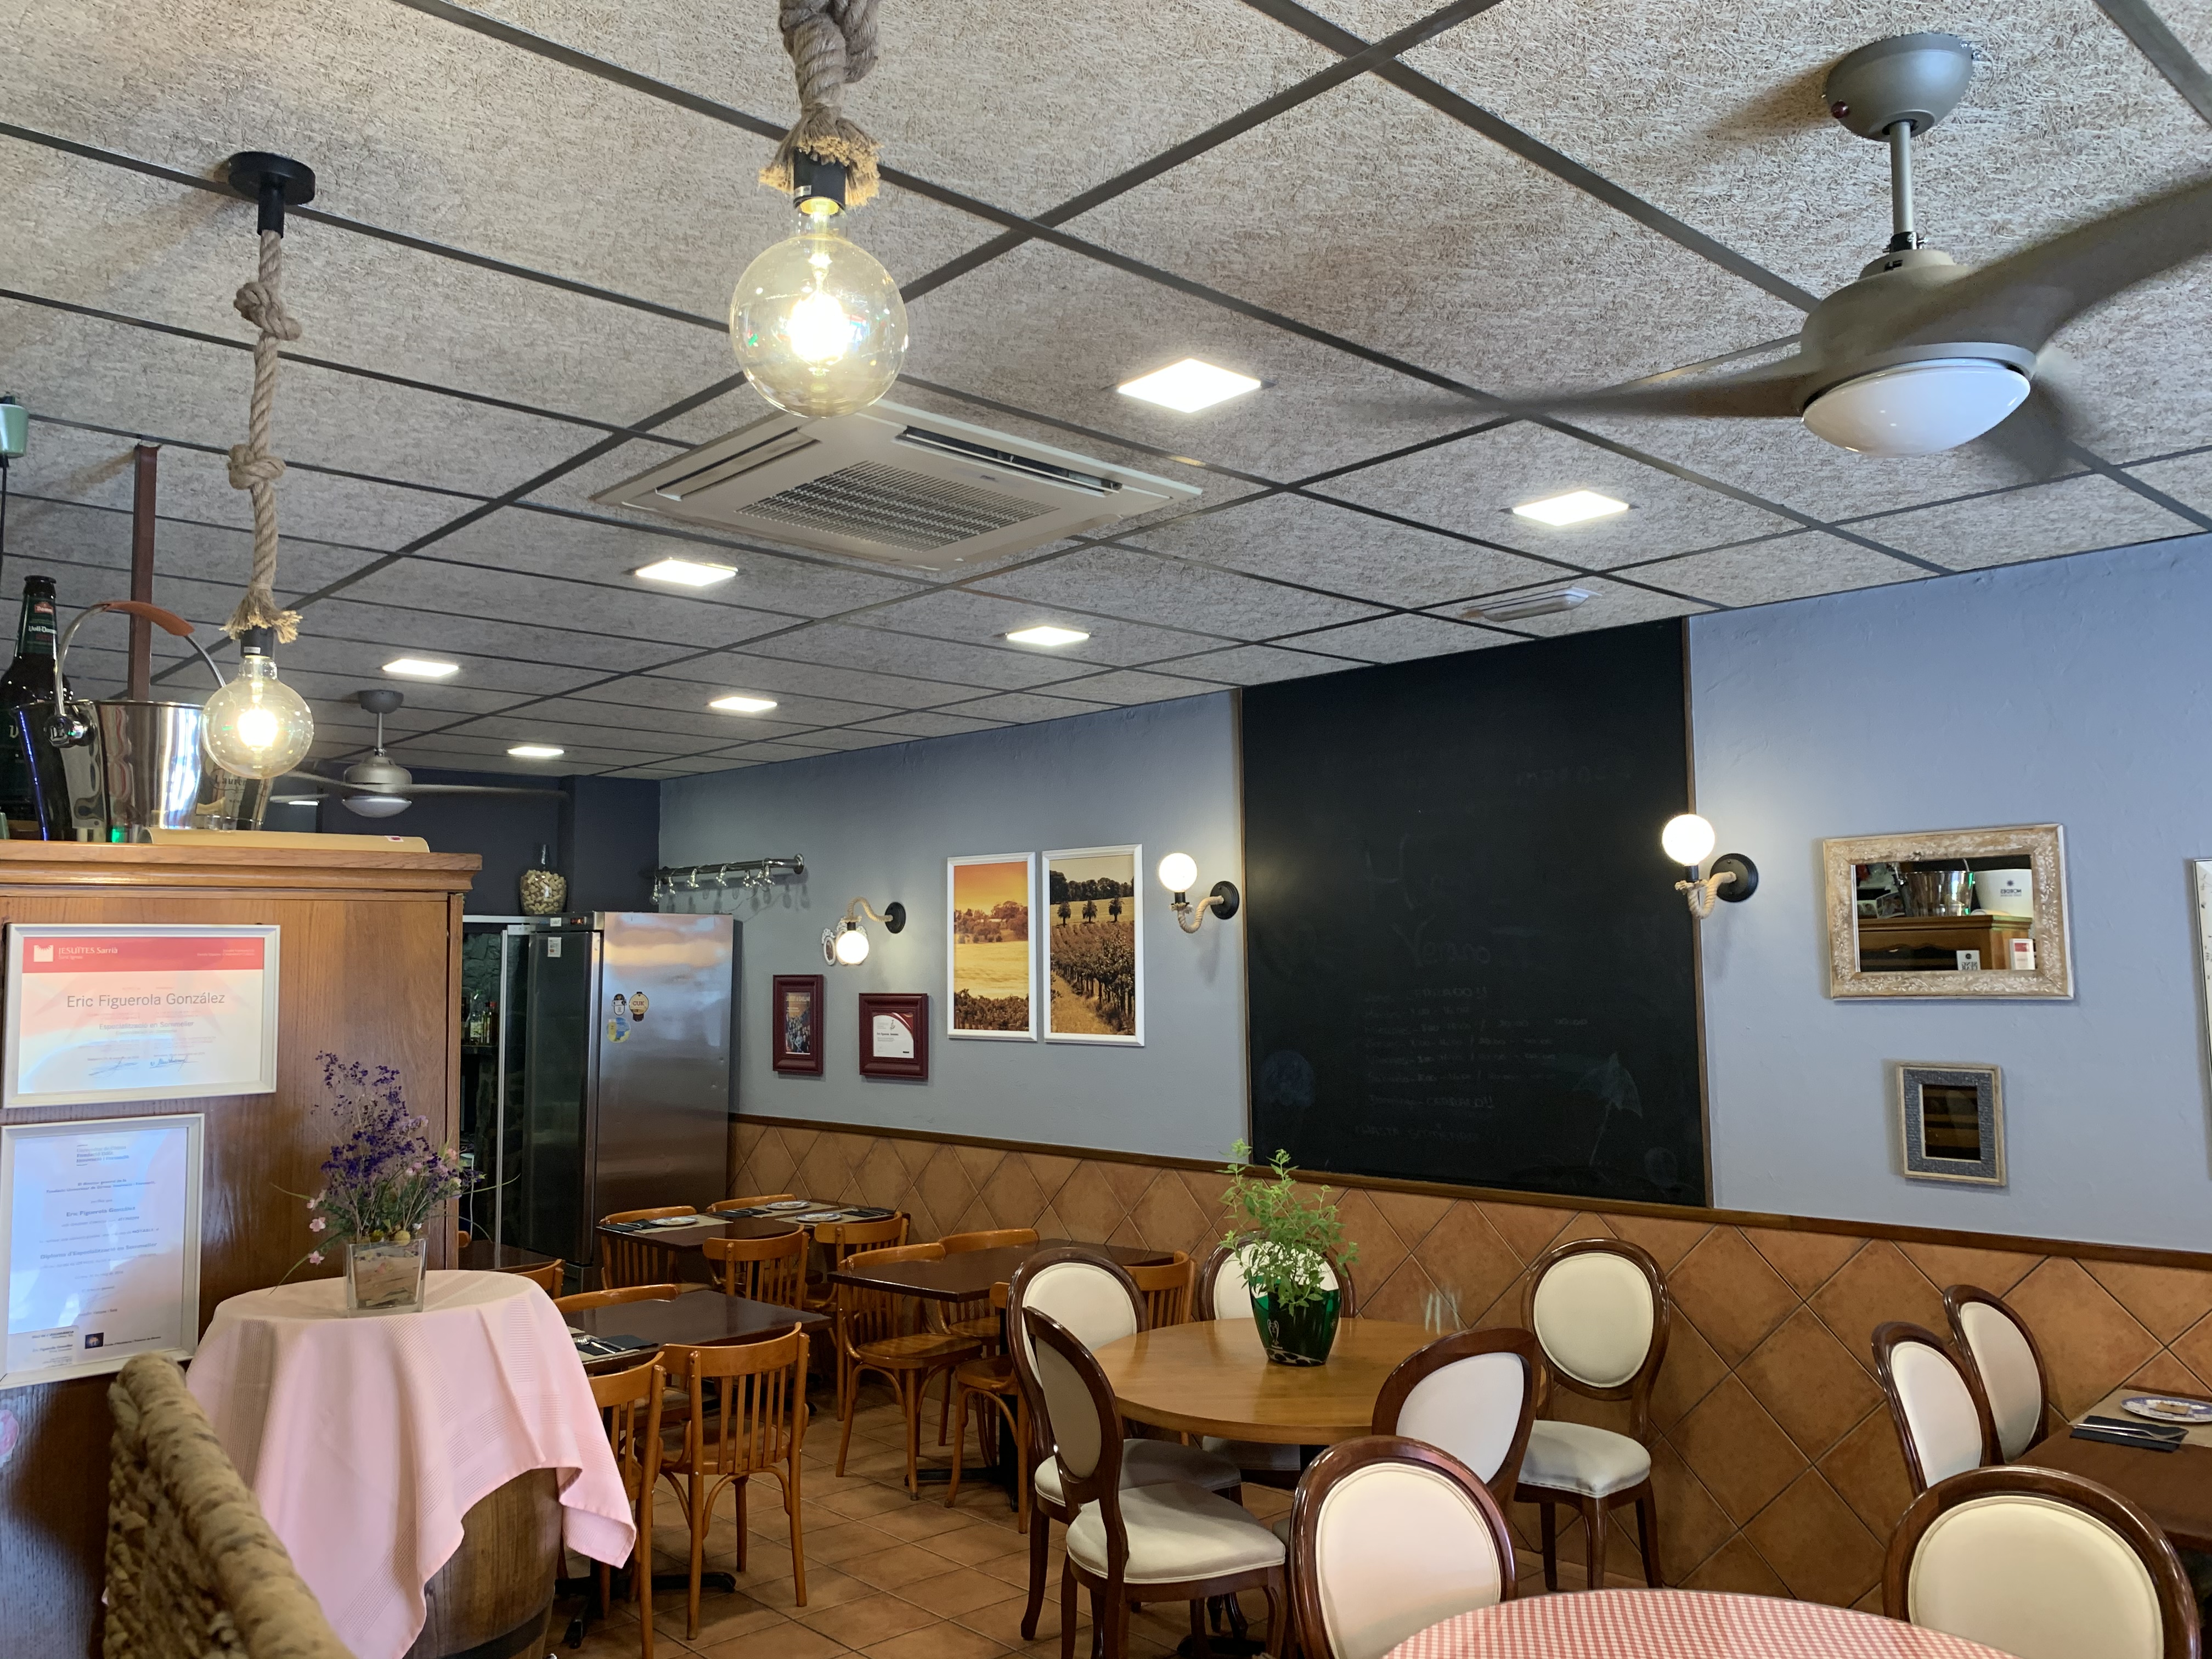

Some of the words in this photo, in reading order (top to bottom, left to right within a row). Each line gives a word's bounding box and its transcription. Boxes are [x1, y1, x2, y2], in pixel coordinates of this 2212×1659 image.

[67, 995, 93, 1007] Eric
[99, 994, 161, 1009] Figuerola
[166, 992, 225, 1005] González
